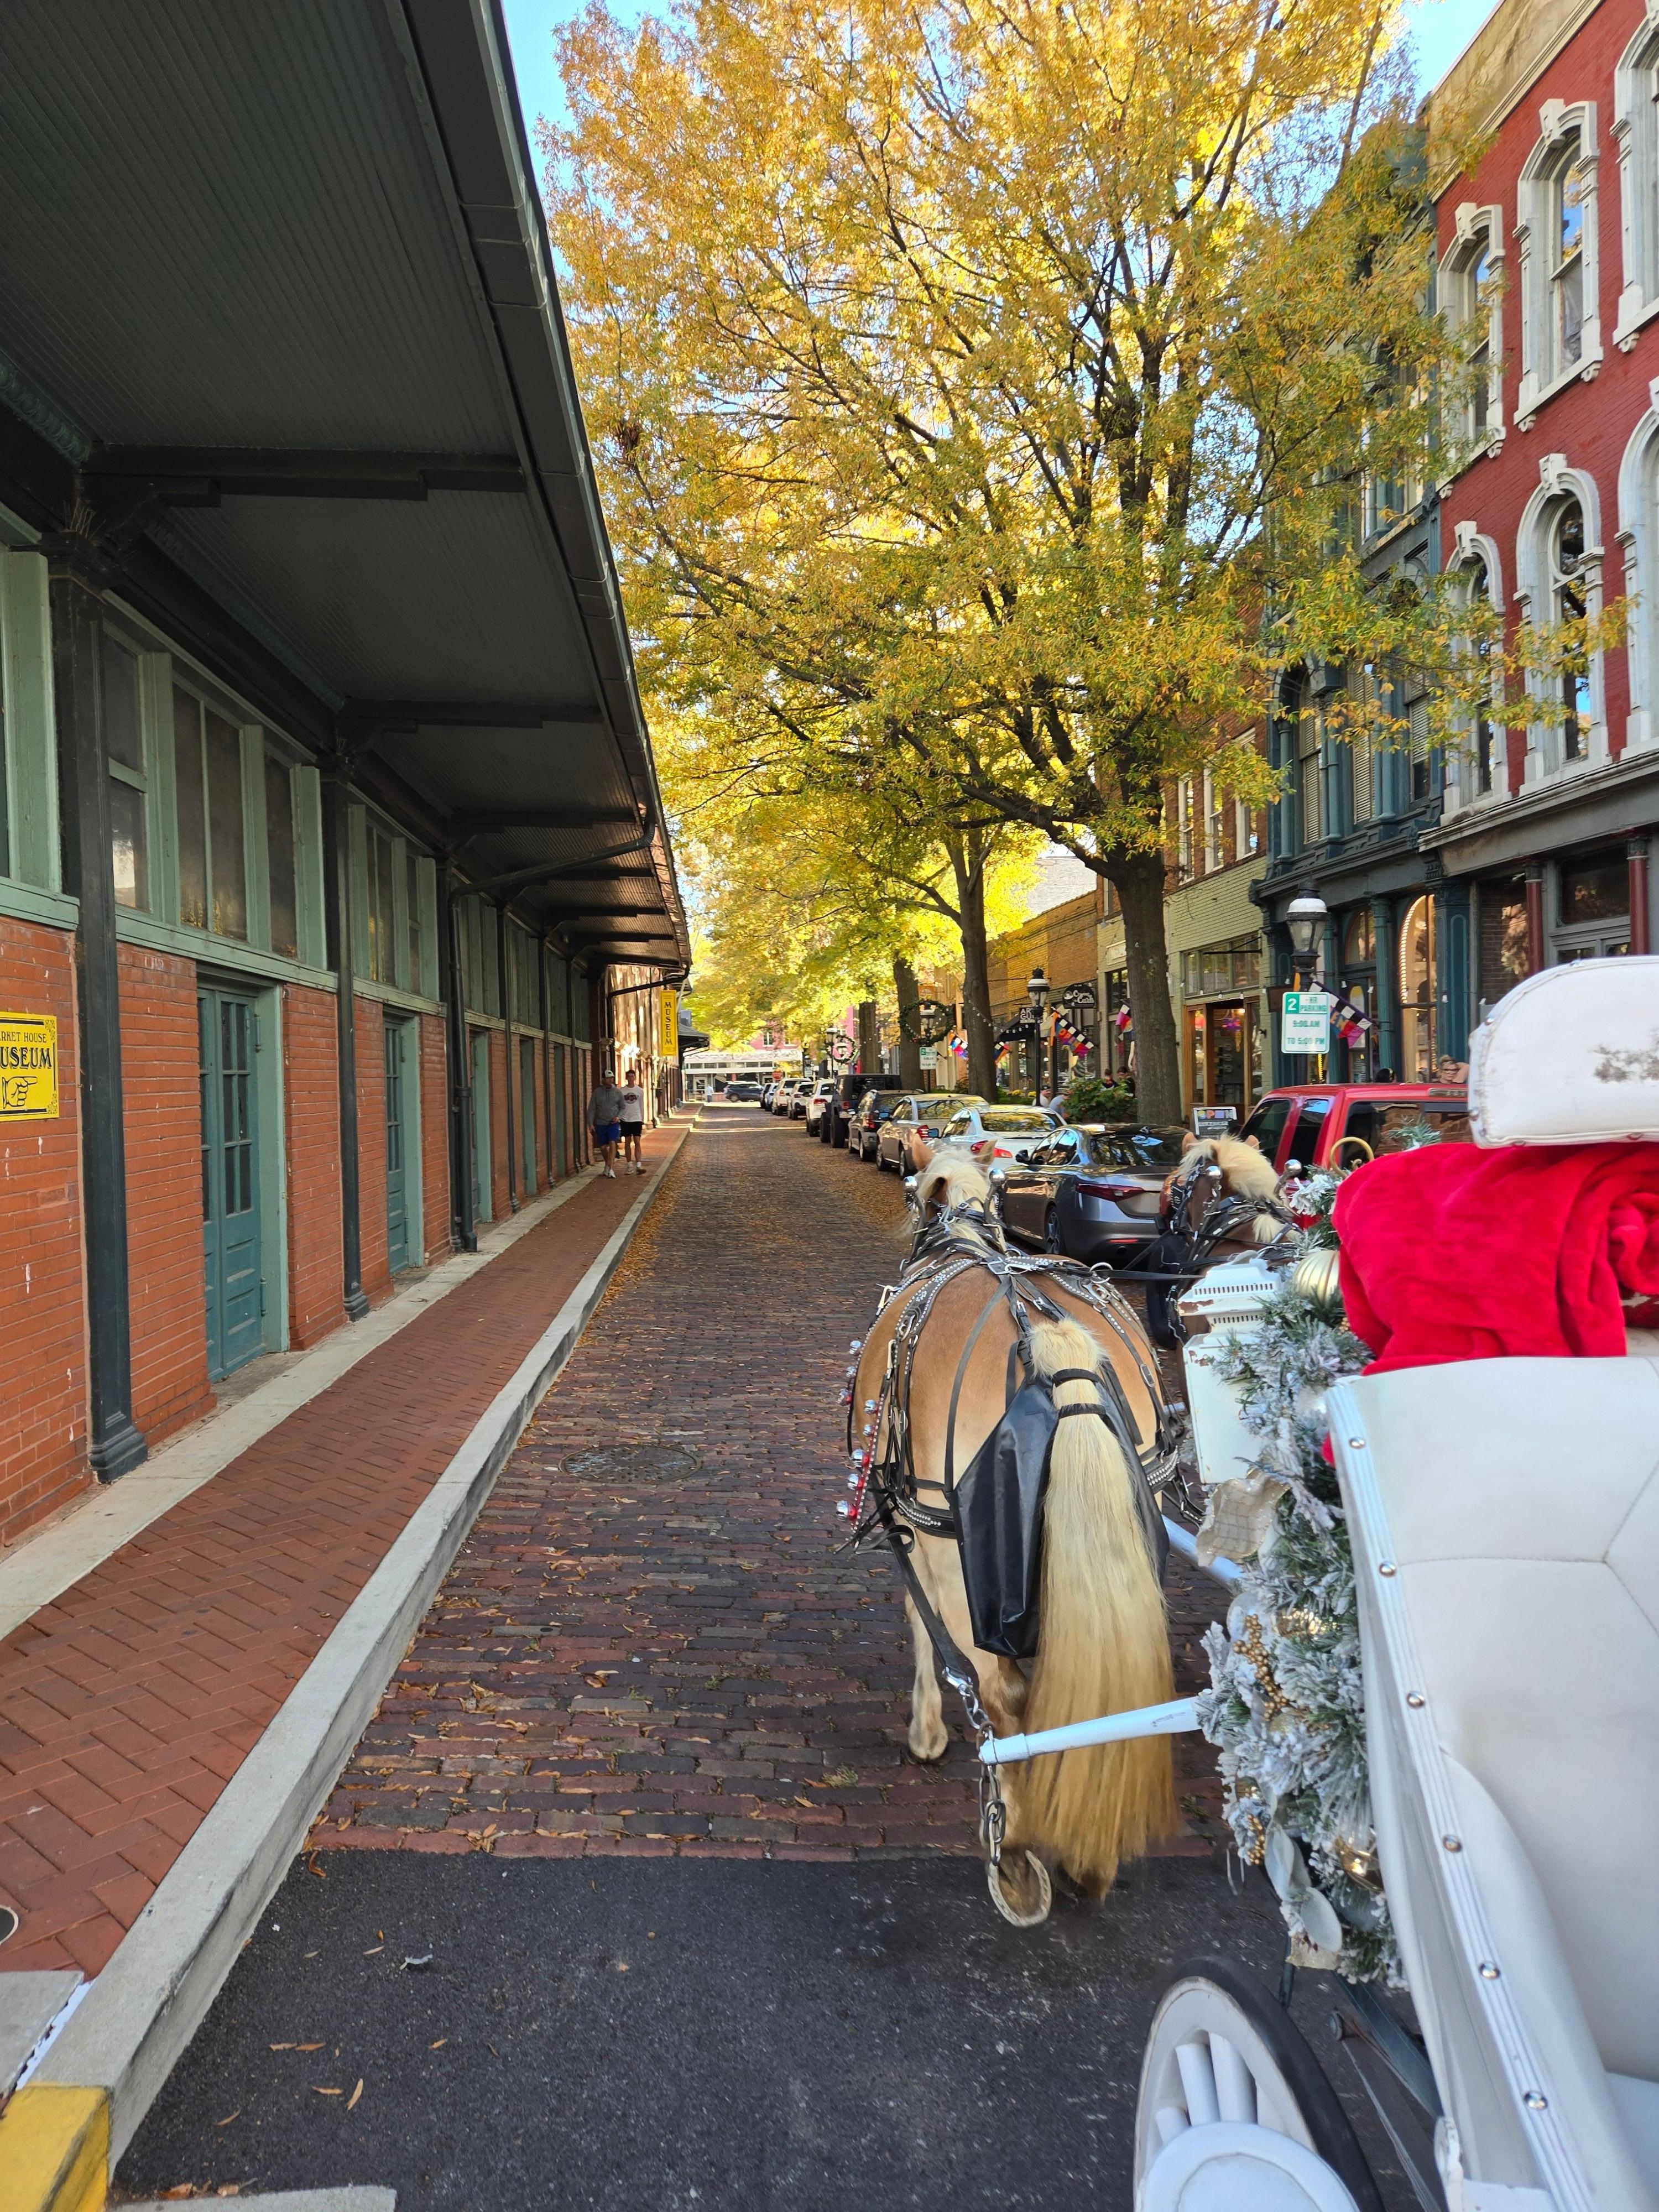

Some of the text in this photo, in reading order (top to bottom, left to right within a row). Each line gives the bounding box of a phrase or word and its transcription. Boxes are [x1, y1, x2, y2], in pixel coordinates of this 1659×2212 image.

[1288, 998, 1297, 1010] 2
[664, 1001, 672, 1045] MUSEUM
[0, 1031, 46, 1043] RKET HOUSE
